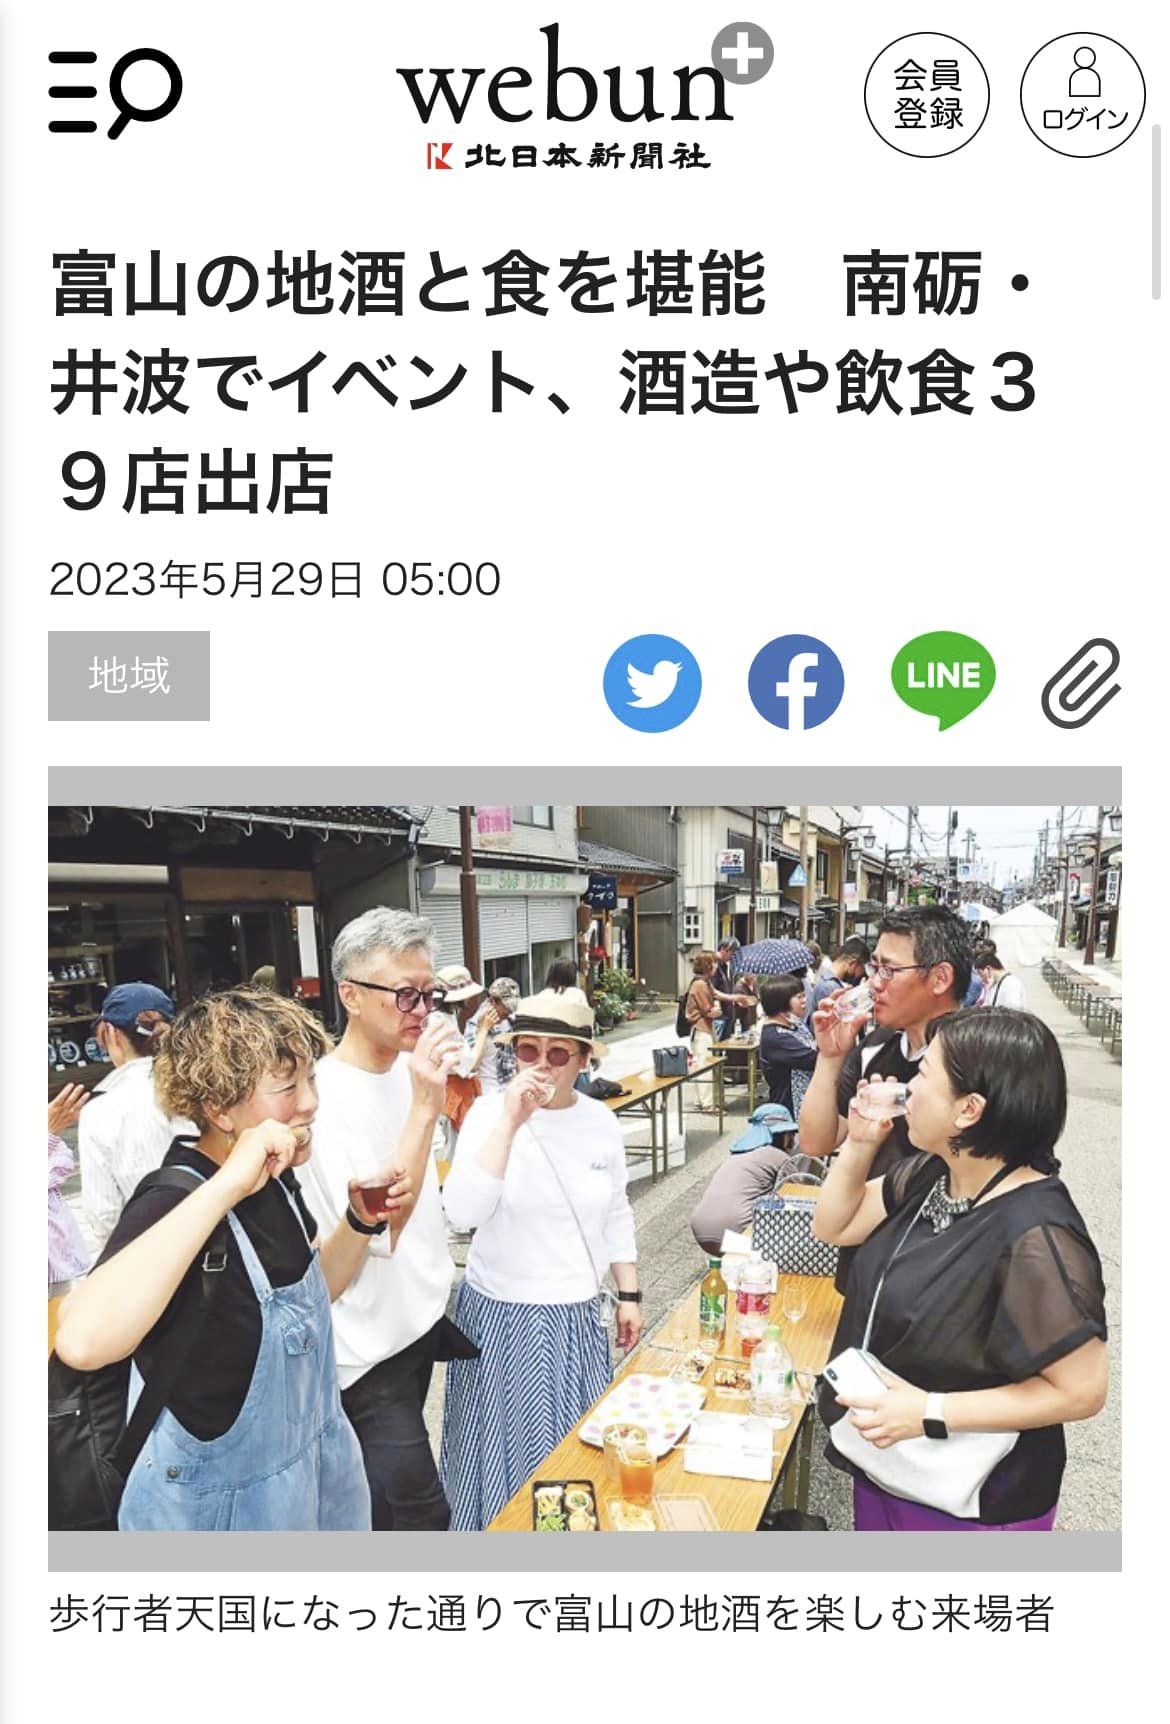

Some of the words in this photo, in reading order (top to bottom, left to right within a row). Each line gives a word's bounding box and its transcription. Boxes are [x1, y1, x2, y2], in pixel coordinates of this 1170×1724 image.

[893, 58, 963, 92] 会員
[893, 97, 964, 130] 登録
[1043, 107, 1129, 131] ログイン
[464, 142, 712, 170] 北日本新聞社
[52, 248, 766, 317] 富山の地酒と食を堪能
[842, 248, 1030, 317] 南砺・
[61, 446, 334, 515] ９店出店
[50, 559, 361, 599] 2023年5月29日
[382, 561, 501, 596] 05:00
[88, 655, 171, 695] 地域
[908, 662, 981, 688] LINE
[49, 1593, 1055, 1633] 歩行者天国になった通りで富山の地酒を楽しむ来場者
